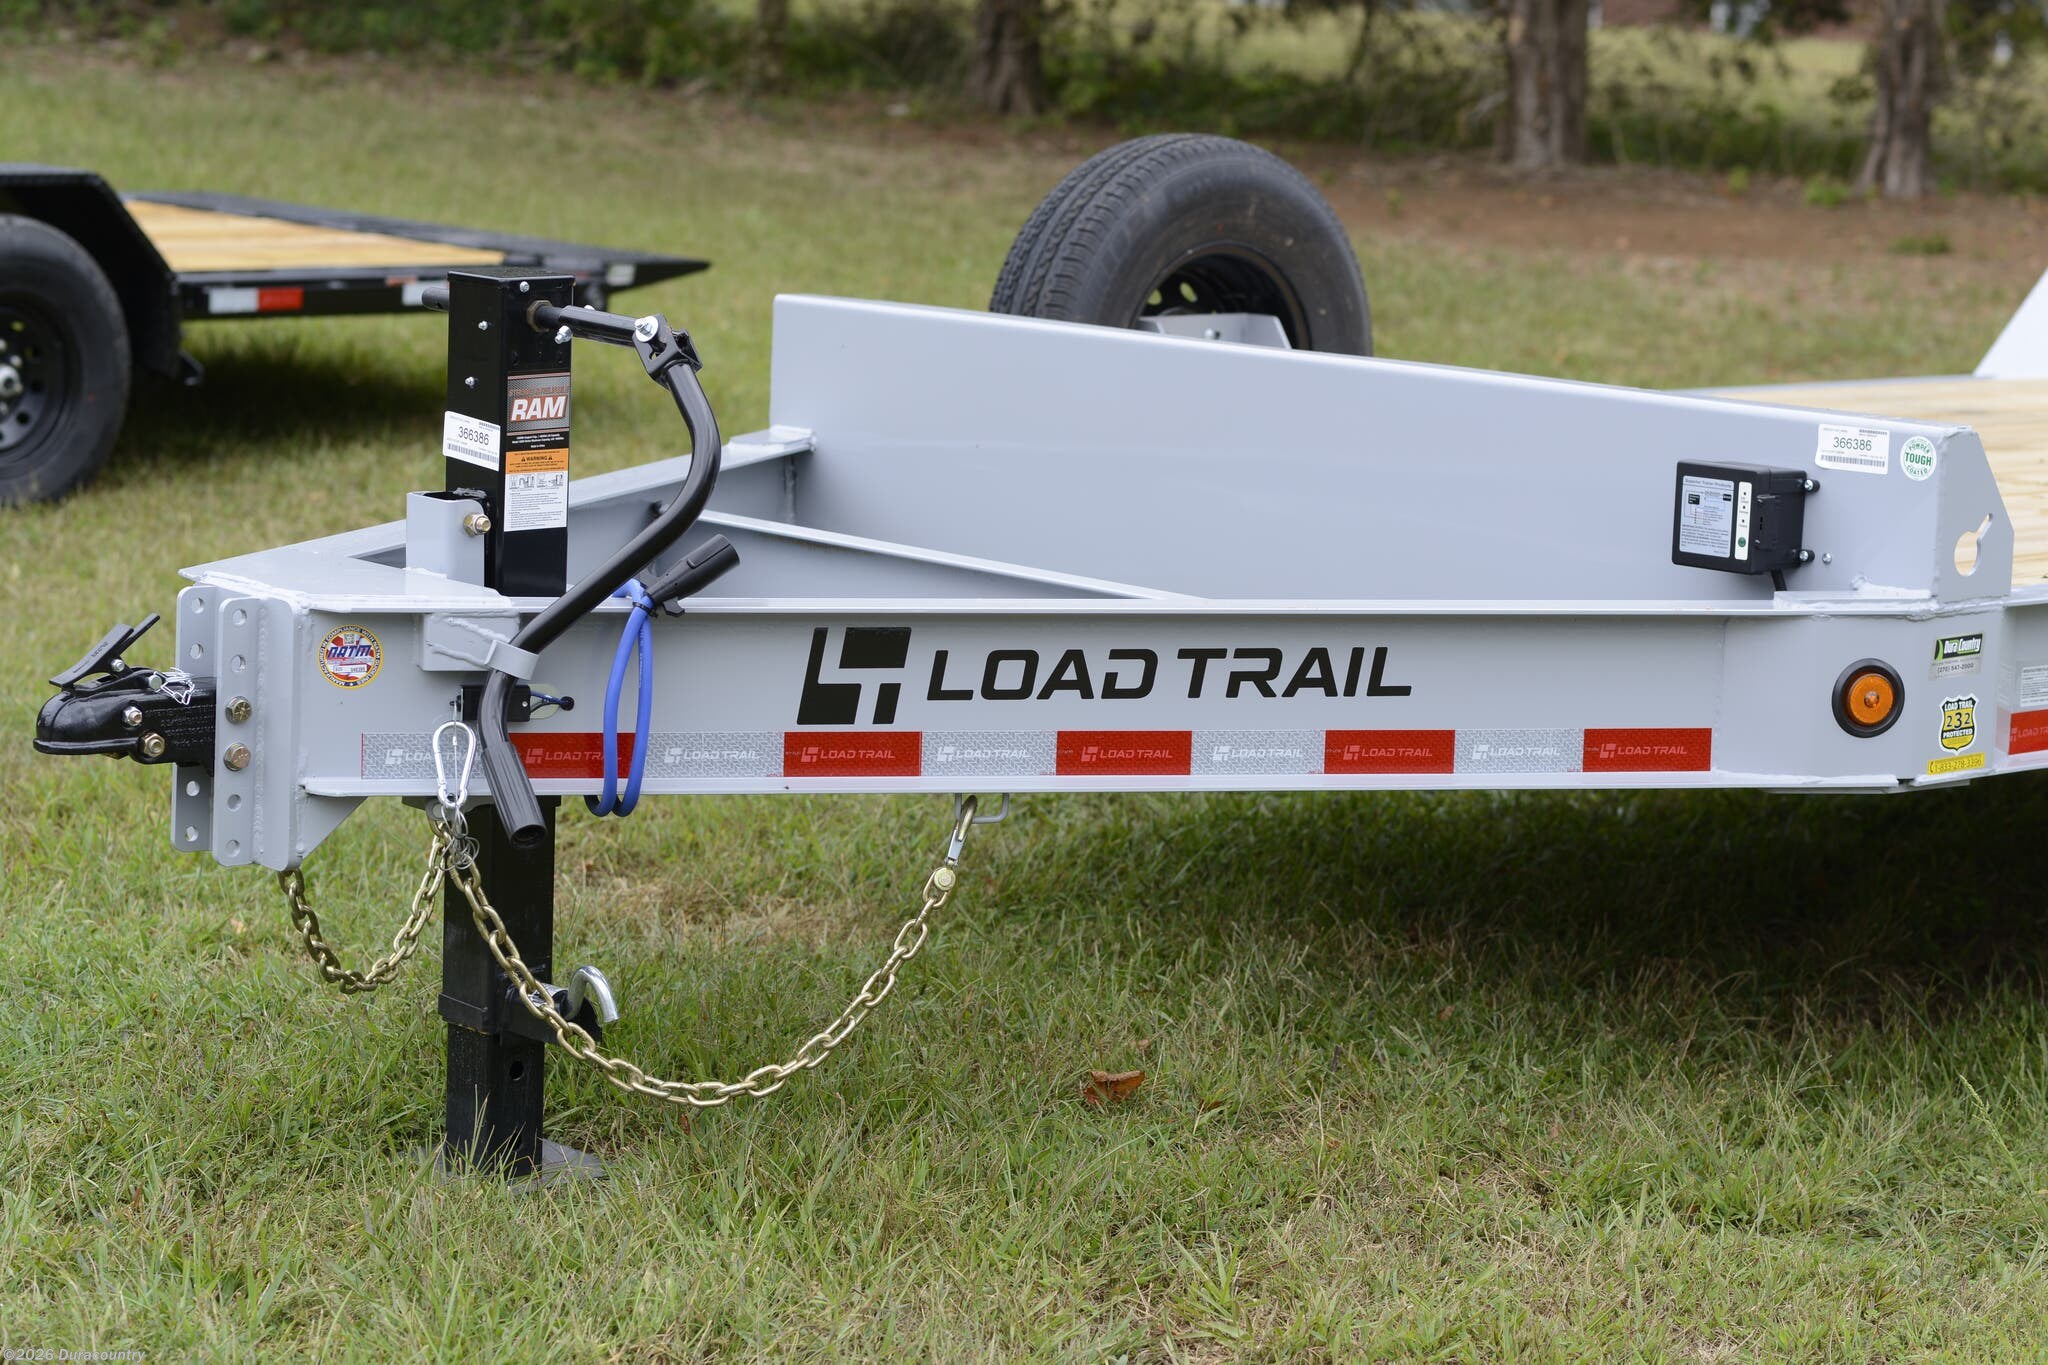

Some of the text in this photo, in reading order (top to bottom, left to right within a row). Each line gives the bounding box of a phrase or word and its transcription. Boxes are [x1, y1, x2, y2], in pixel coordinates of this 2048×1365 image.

[511, 395, 567, 421] RAM
[458, 426, 489, 445] 366386
[1833, 437, 1872, 451] 366386
[1909, 442, 1930, 453] POWDER
[1905, 452, 1932, 466] TOUGH
[1906, 465, 1928, 475] COATED
[1944, 637, 1981, 654] Dura Country
[327, 645, 372, 658] NATM
[927, 649, 1158, 700] LOAD
[1177, 647, 1412, 698] TRAIL
[1944, 700, 1973, 711] LOAD TRAIL
[1946, 712, 1970, 728] 232
[1943, 728, 1973, 739] PROTECTED
[545, 751, 582, 760] LOAD
[684, 751, 760, 760] LOAD TRAIL
[821, 749, 895, 759] LOAD TRAIL
[956, 749, 1031, 759] LOAD TRAIL
[1099, 748, 1173, 759] LOAD TRAIL
[1267, 749, 1303, 758] TRAIL
[1361, 748, 1433, 757] LOAD TRAIL
[1617, 746, 1688, 755] LOAD TRAIL
